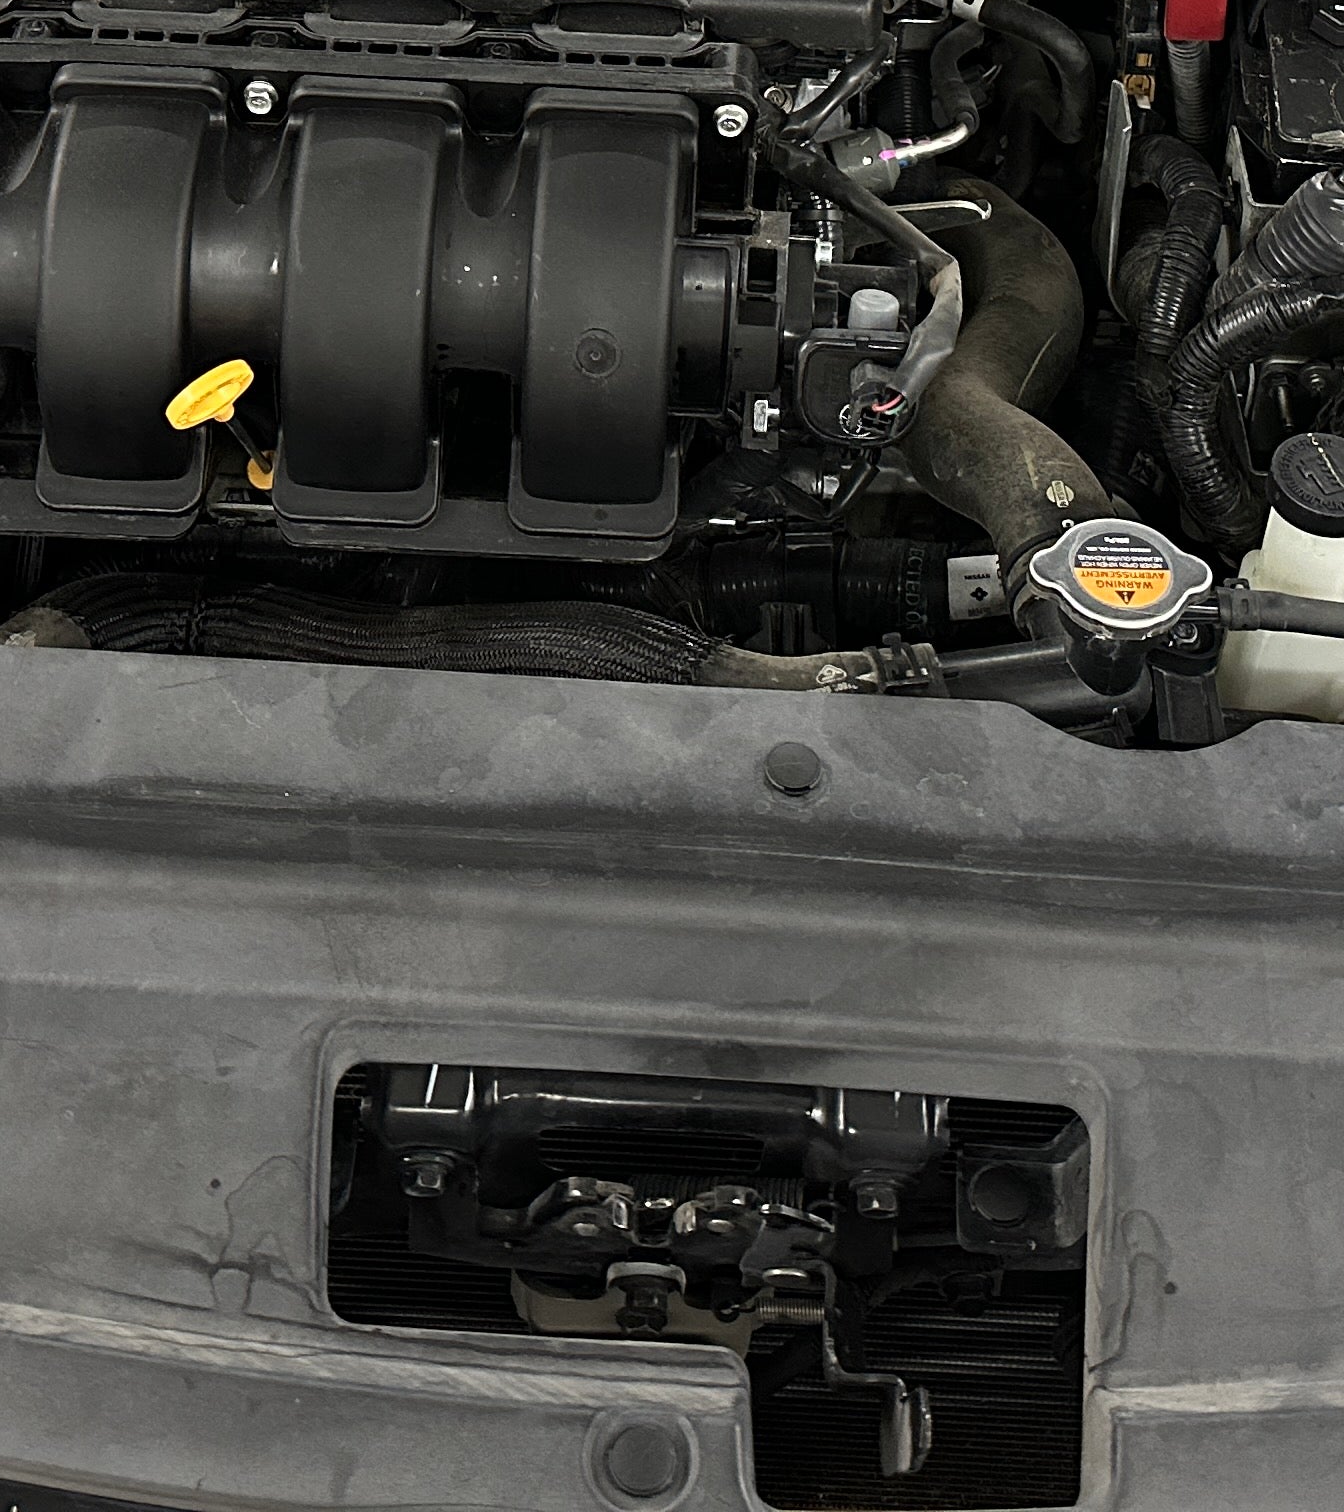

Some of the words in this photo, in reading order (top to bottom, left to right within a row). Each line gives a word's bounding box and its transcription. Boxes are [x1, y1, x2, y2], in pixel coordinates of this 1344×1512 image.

[964, 572, 991, 581] NISSAN
[1080, 570, 1166, 580] AVERTISSEMENT
[1095, 580, 1154, 590] WARNING
